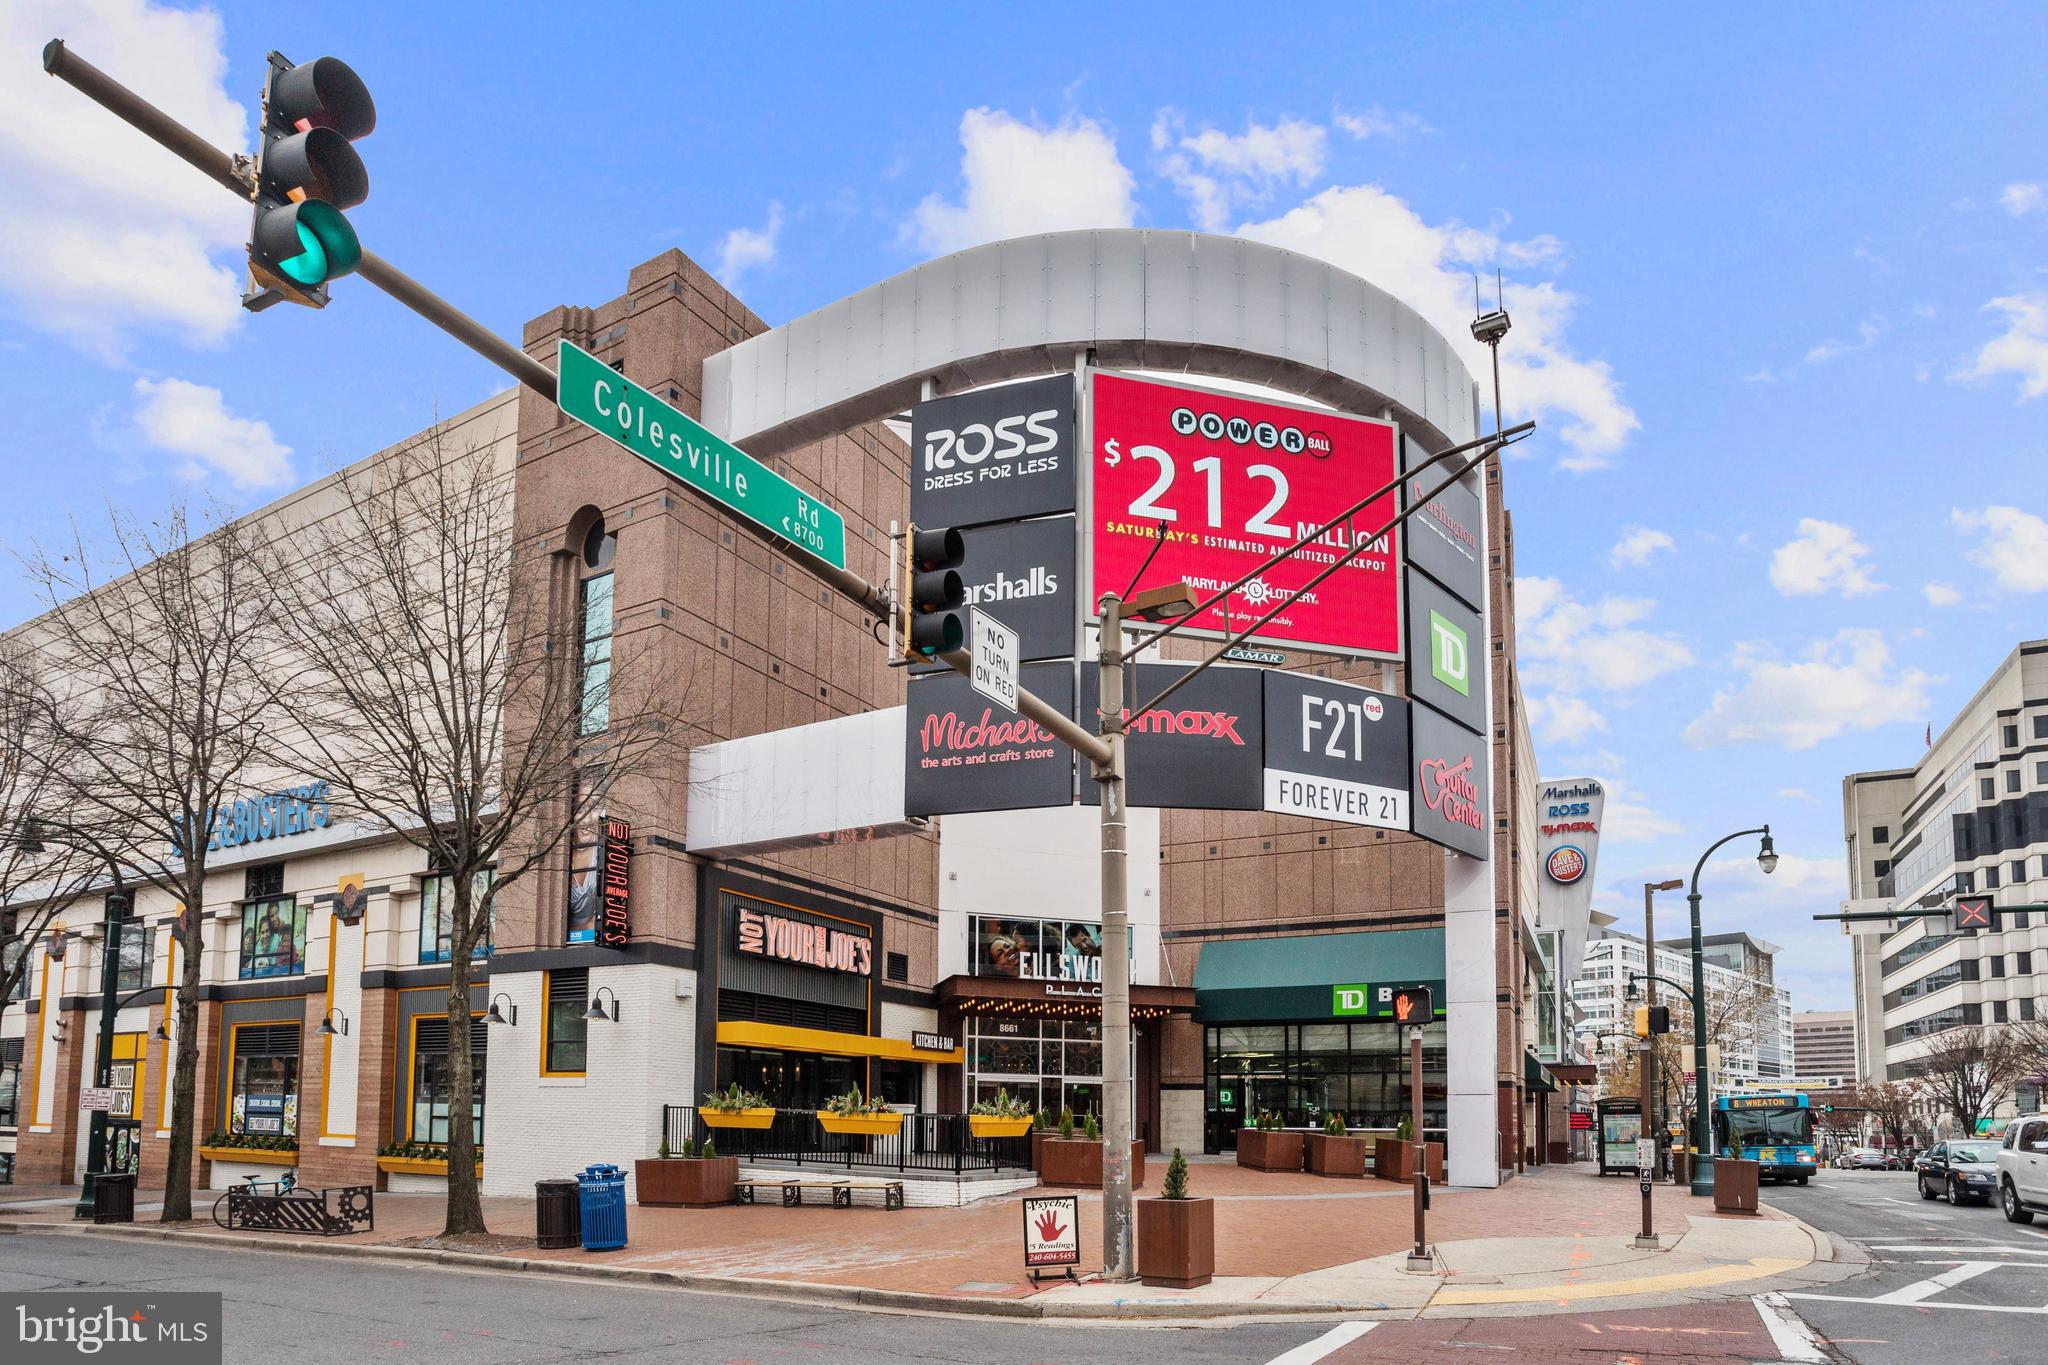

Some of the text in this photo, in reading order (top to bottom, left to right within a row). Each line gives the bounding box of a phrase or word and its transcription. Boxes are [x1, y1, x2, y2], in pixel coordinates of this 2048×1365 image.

[594, 379, 748, 498] Colesville
[925, 409, 1058, 472] ROSS
[924, 456, 1058, 491] DRESS FOR LESS
[798, 497, 819, 529] Rd
[794, 522, 824, 551] 8700
[1296, 521, 1389, 555] MILLION
[1204, 536, 1265, 555] ESTIMATED
[1341, 555, 1386, 572] ACKPOT
[962, 566, 1058, 606] arshalls
[1236, 611, 1252, 622] play
[987, 627, 1005, 650] NO
[982, 645, 1009, 675] TURN
[1228, 650, 1279, 662] LAMAR
[1433, 622, 1467, 680] TD
[976, 665, 1014, 699] ON RED
[1302, 694, 1381, 761] F21 red
[921, 748, 1055, 769] the arts and crafts store
[1279, 779, 1397, 820] FOREVER 21
[1541, 783, 1602, 800] Marshalls
[1442, 793, 1485, 831] Center
[1548, 803, 1590, 817] ROSS
[608, 821, 630, 839] NOT
[607, 844, 629, 887] YOUR
[1551, 852, 1580, 868] DAVE &
[1552, 861, 1582, 876] BUSTER'S
[606, 887, 629, 898] AVERAGE
[605, 898, 628, 944] JOE'S
[739, 908, 763, 954] NOT
[764, 915, 814, 965] YOUR
[826, 931, 872, 976] JOE'S
[1046, 984, 1102, 997] PLAC
[1336, 989, 1364, 1010] TD
[1000, 1024, 1018, 1033] 8661
[916, 1033, 954, 1051] KITCHEN & BAR
[117, 1067, 133, 1087] YOUR
[112, 1091, 131, 1114] JOE'S
[1027, 1199, 1072, 1211] Psychic
[1038, 1241, 1075, 1250] Readings
